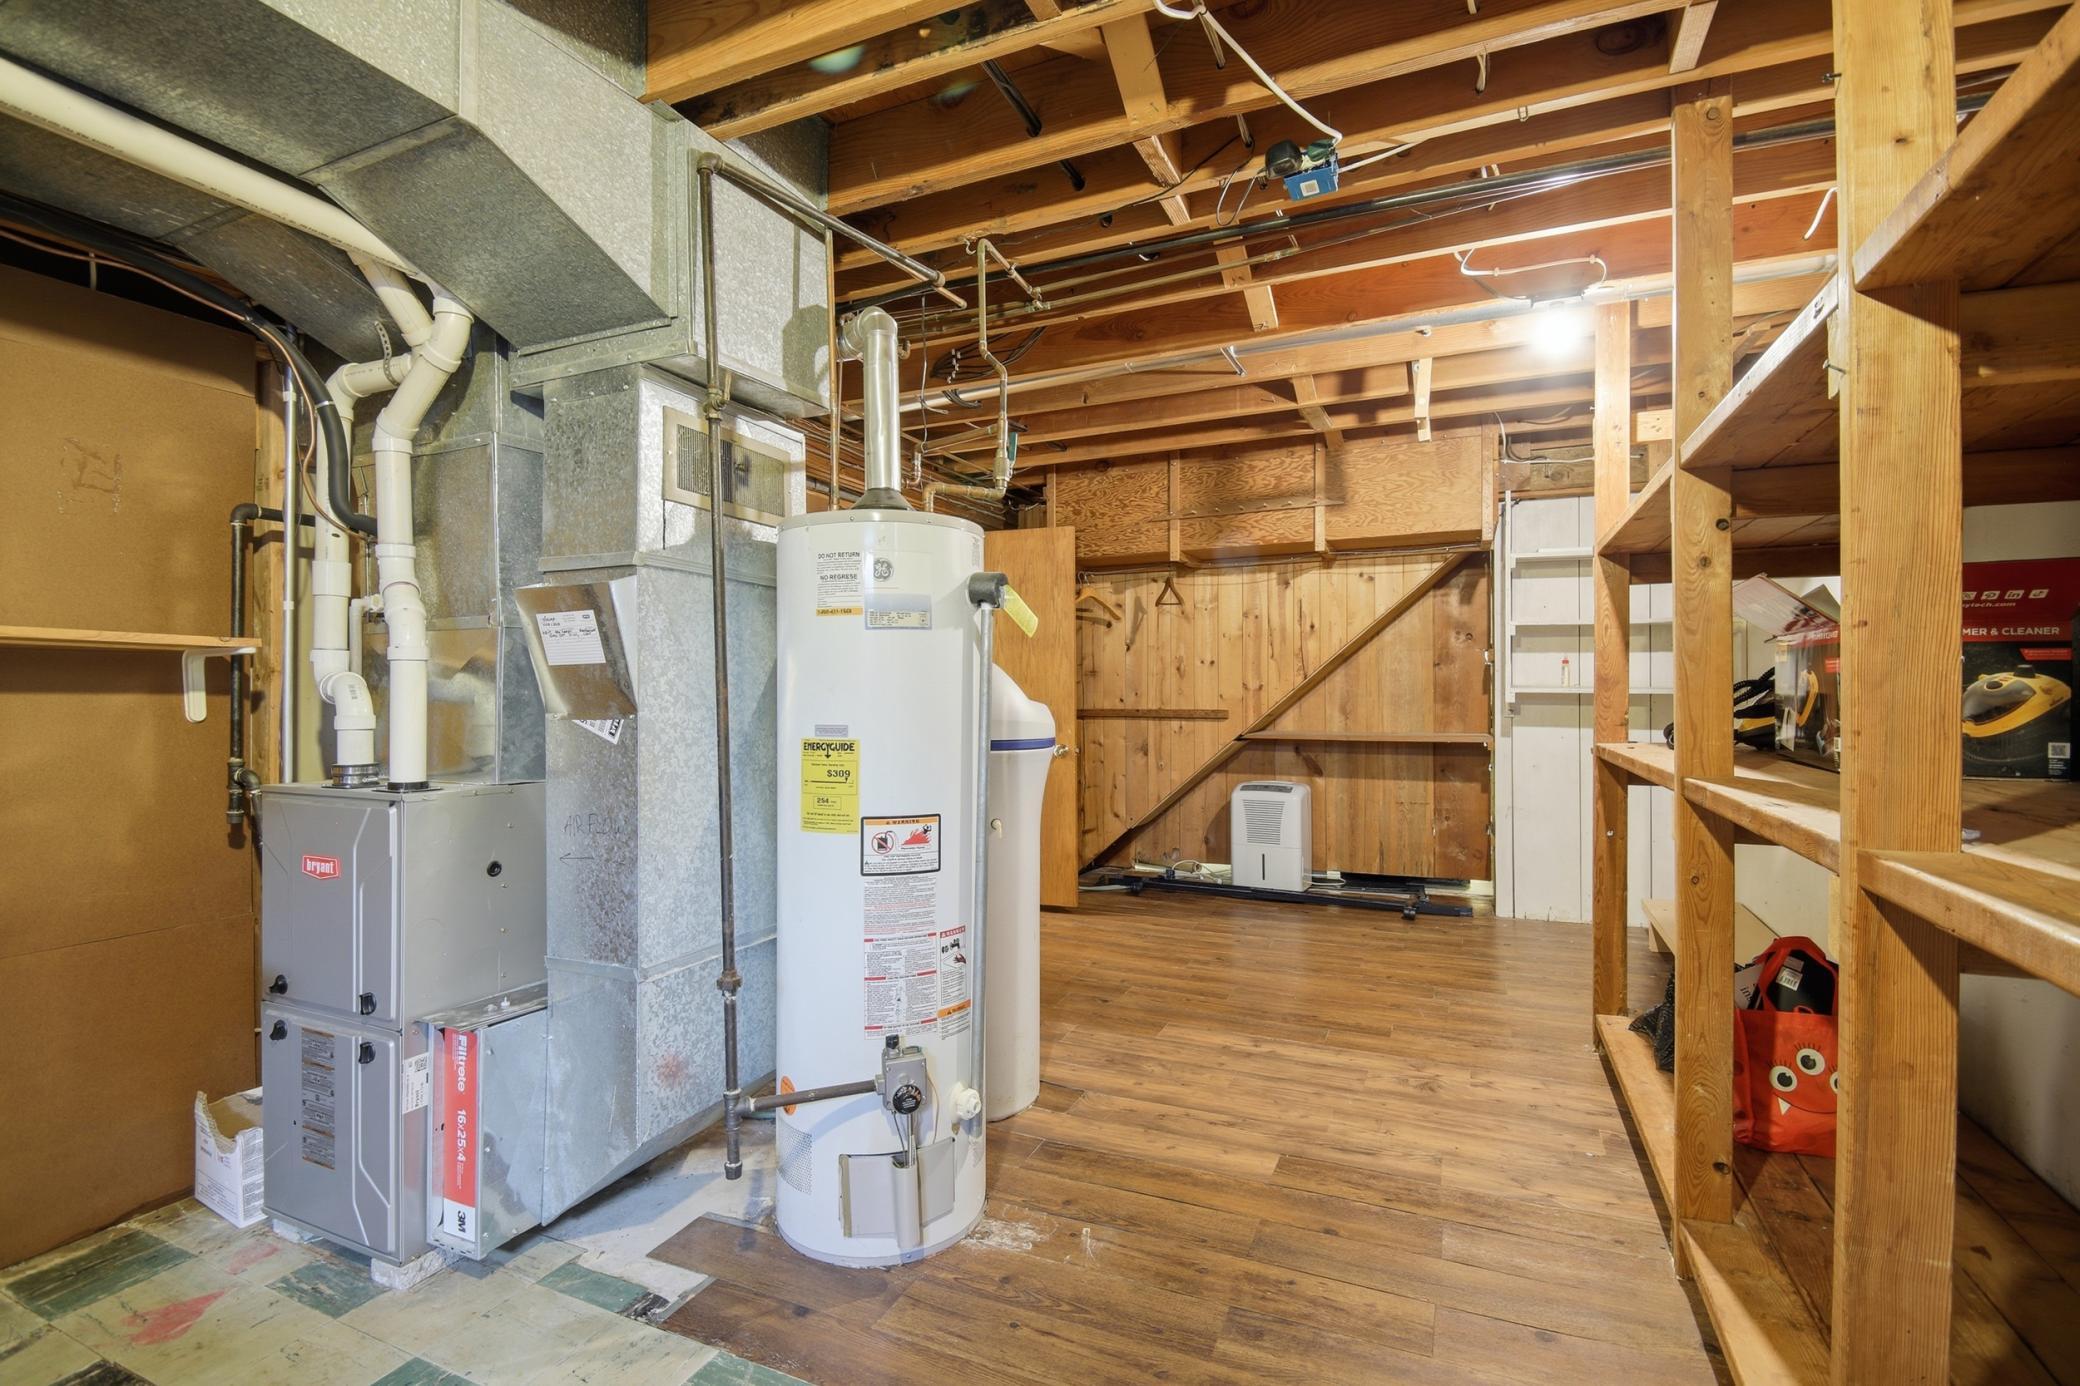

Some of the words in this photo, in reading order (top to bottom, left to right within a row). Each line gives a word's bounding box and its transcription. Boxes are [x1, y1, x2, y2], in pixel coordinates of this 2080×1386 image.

[1990, 627, 1998, 635] &
[2001, 627, 2060, 635] CLEANER
[803, 742, 855, 751] ENERGYGUIDE
[827, 769, 851, 777] $309
[306, 858, 334, 874] bryant
[457, 1035, 467, 1092] Filtrete
[457, 1109, 466, 1161] 16x25x4
[457, 1210, 466, 1232] 3M
